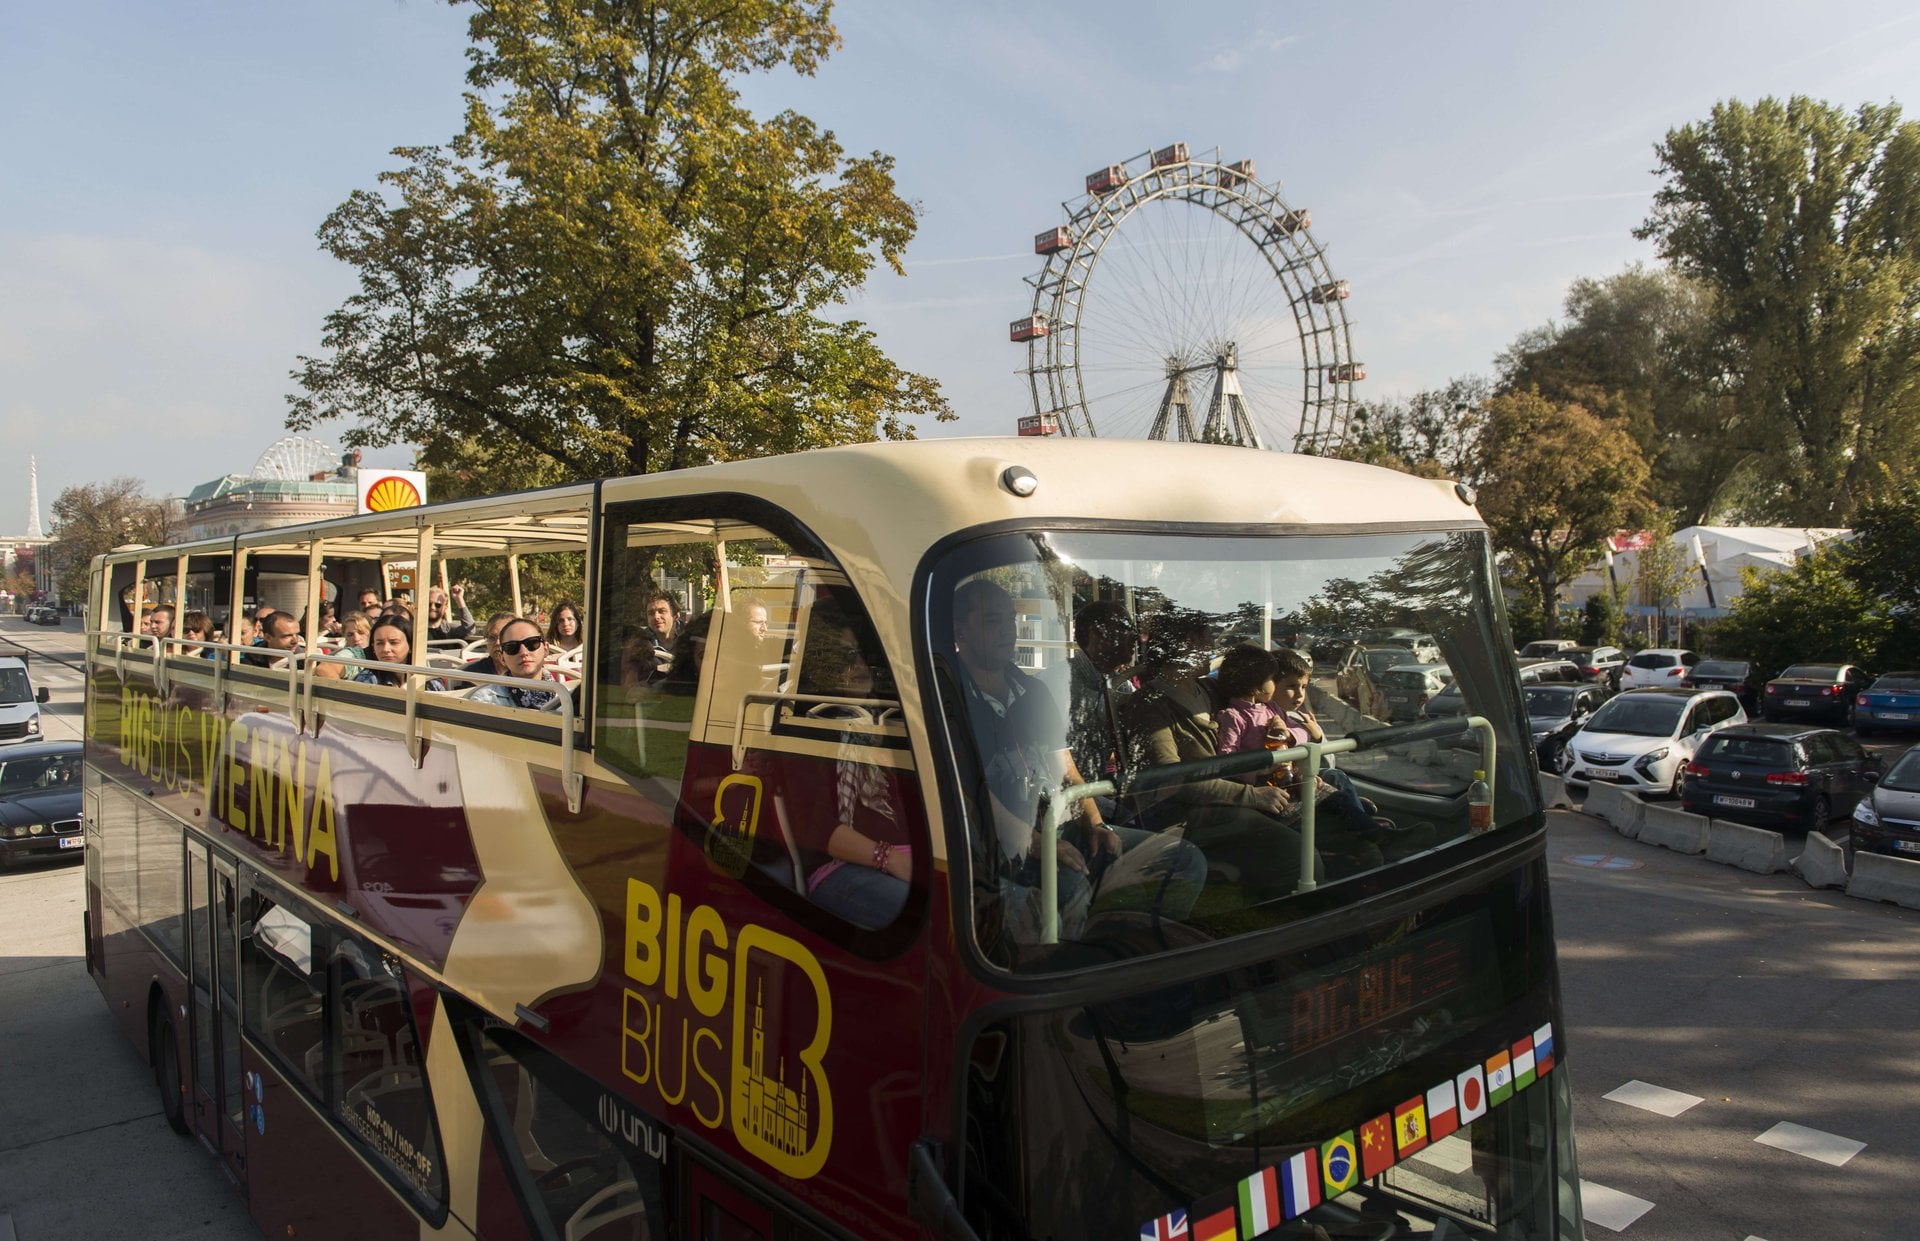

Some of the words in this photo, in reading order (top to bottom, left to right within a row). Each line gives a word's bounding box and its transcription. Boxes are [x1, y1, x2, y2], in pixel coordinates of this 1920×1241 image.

[202, 711, 338, 882] VIENNA
[625, 877, 729, 1017] BIG
[622, 987, 724, 1129] BUS
